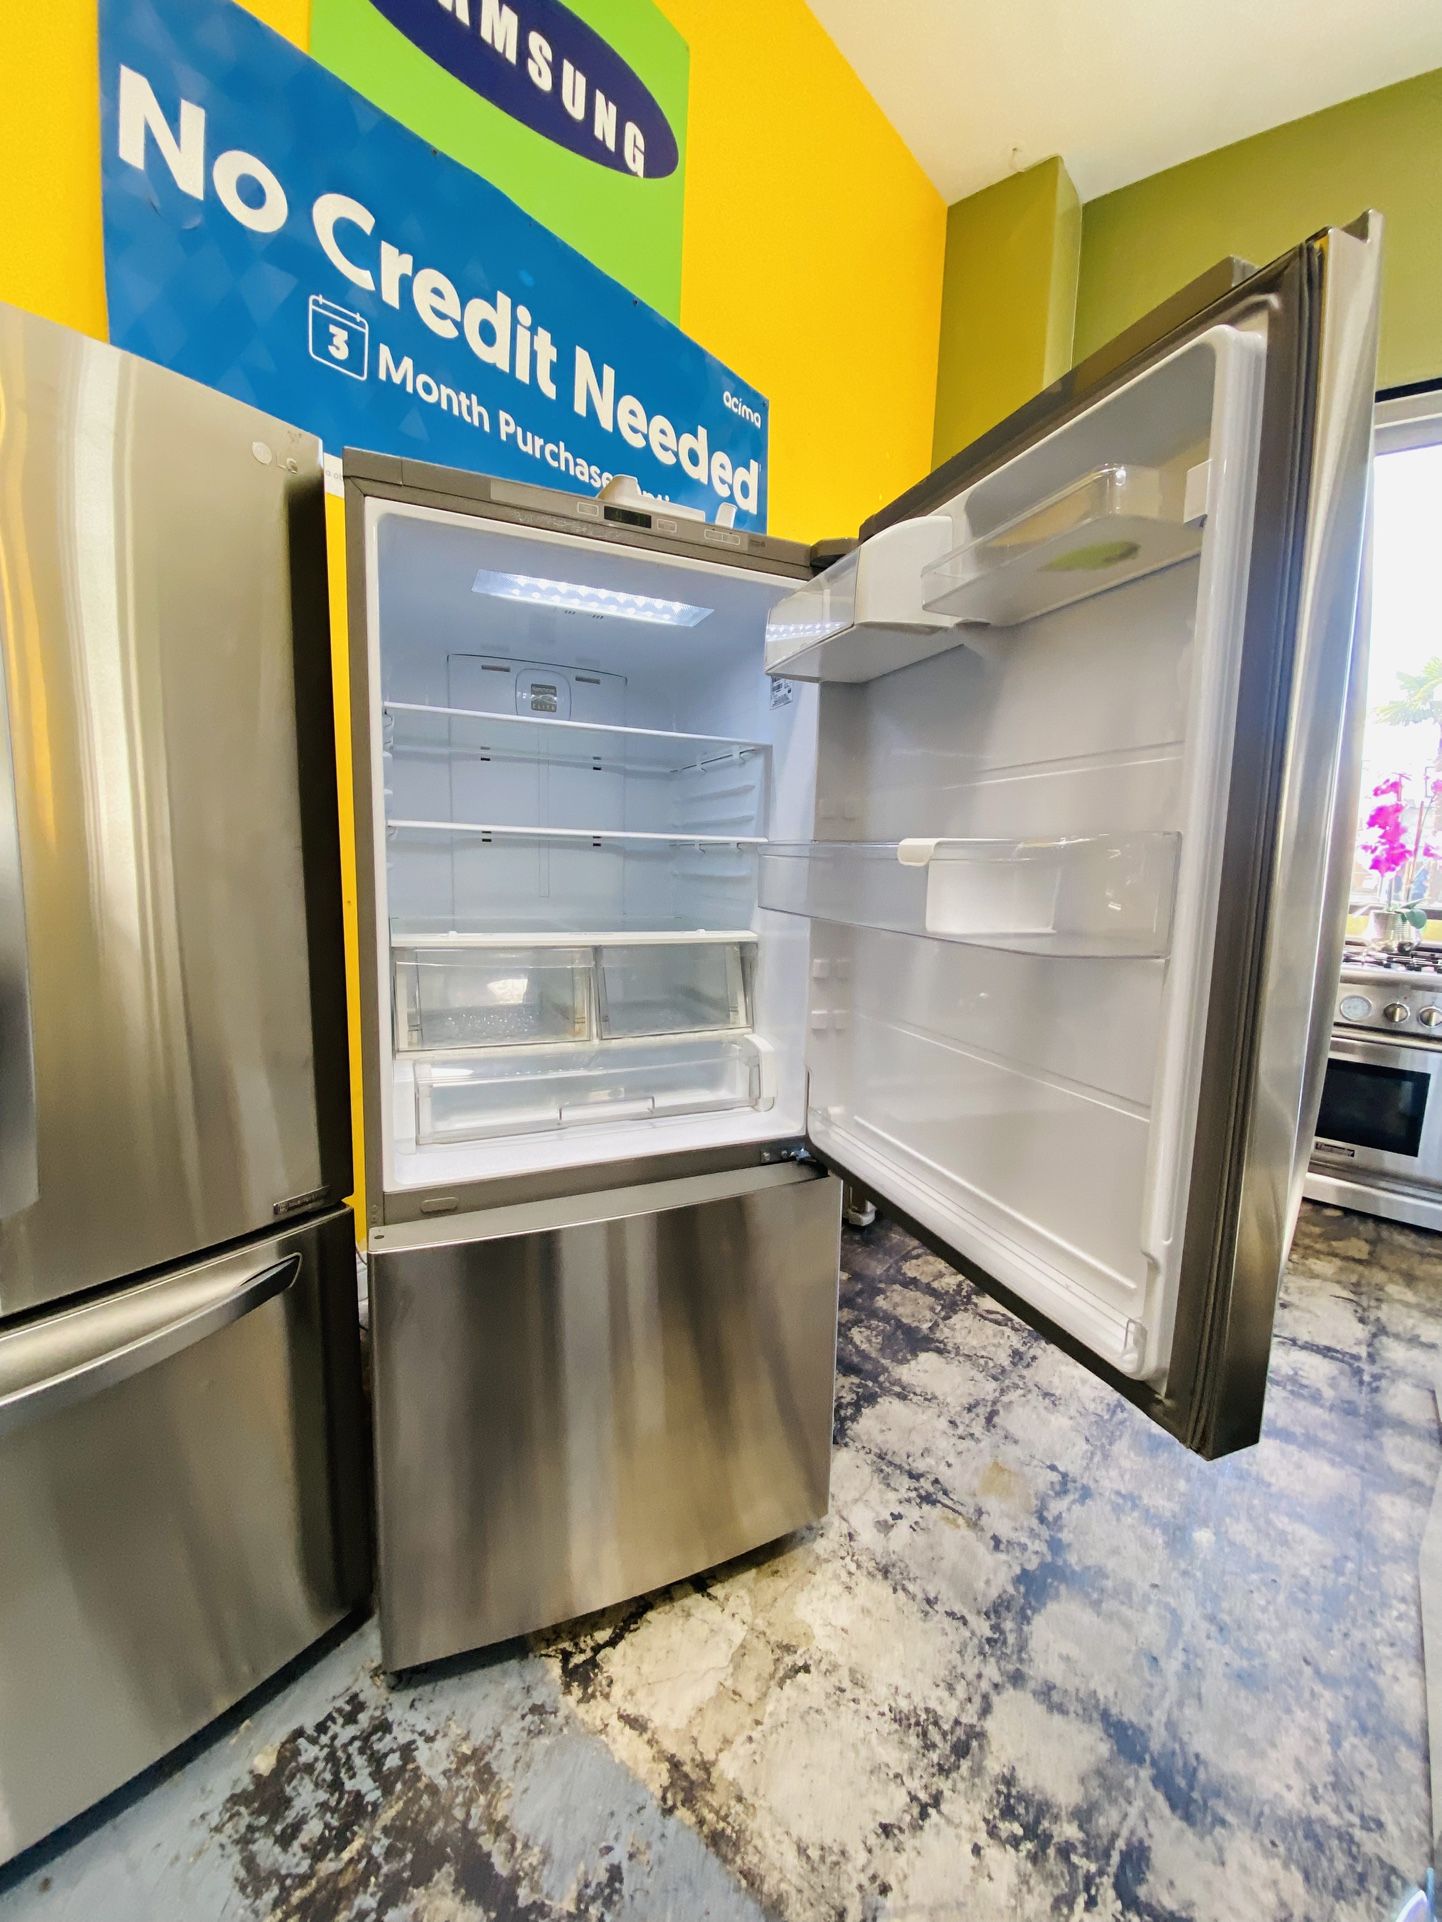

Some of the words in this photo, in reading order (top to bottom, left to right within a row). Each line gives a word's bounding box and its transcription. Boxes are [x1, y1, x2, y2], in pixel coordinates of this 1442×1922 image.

[118, 63, 289, 233] No
[312, 193, 557, 400] Credit
[574, 345, 760, 515] Needed
[328, 324, 349, 361] 3
[378, 342, 490, 433] Month
[723, 391, 761, 429] acima
